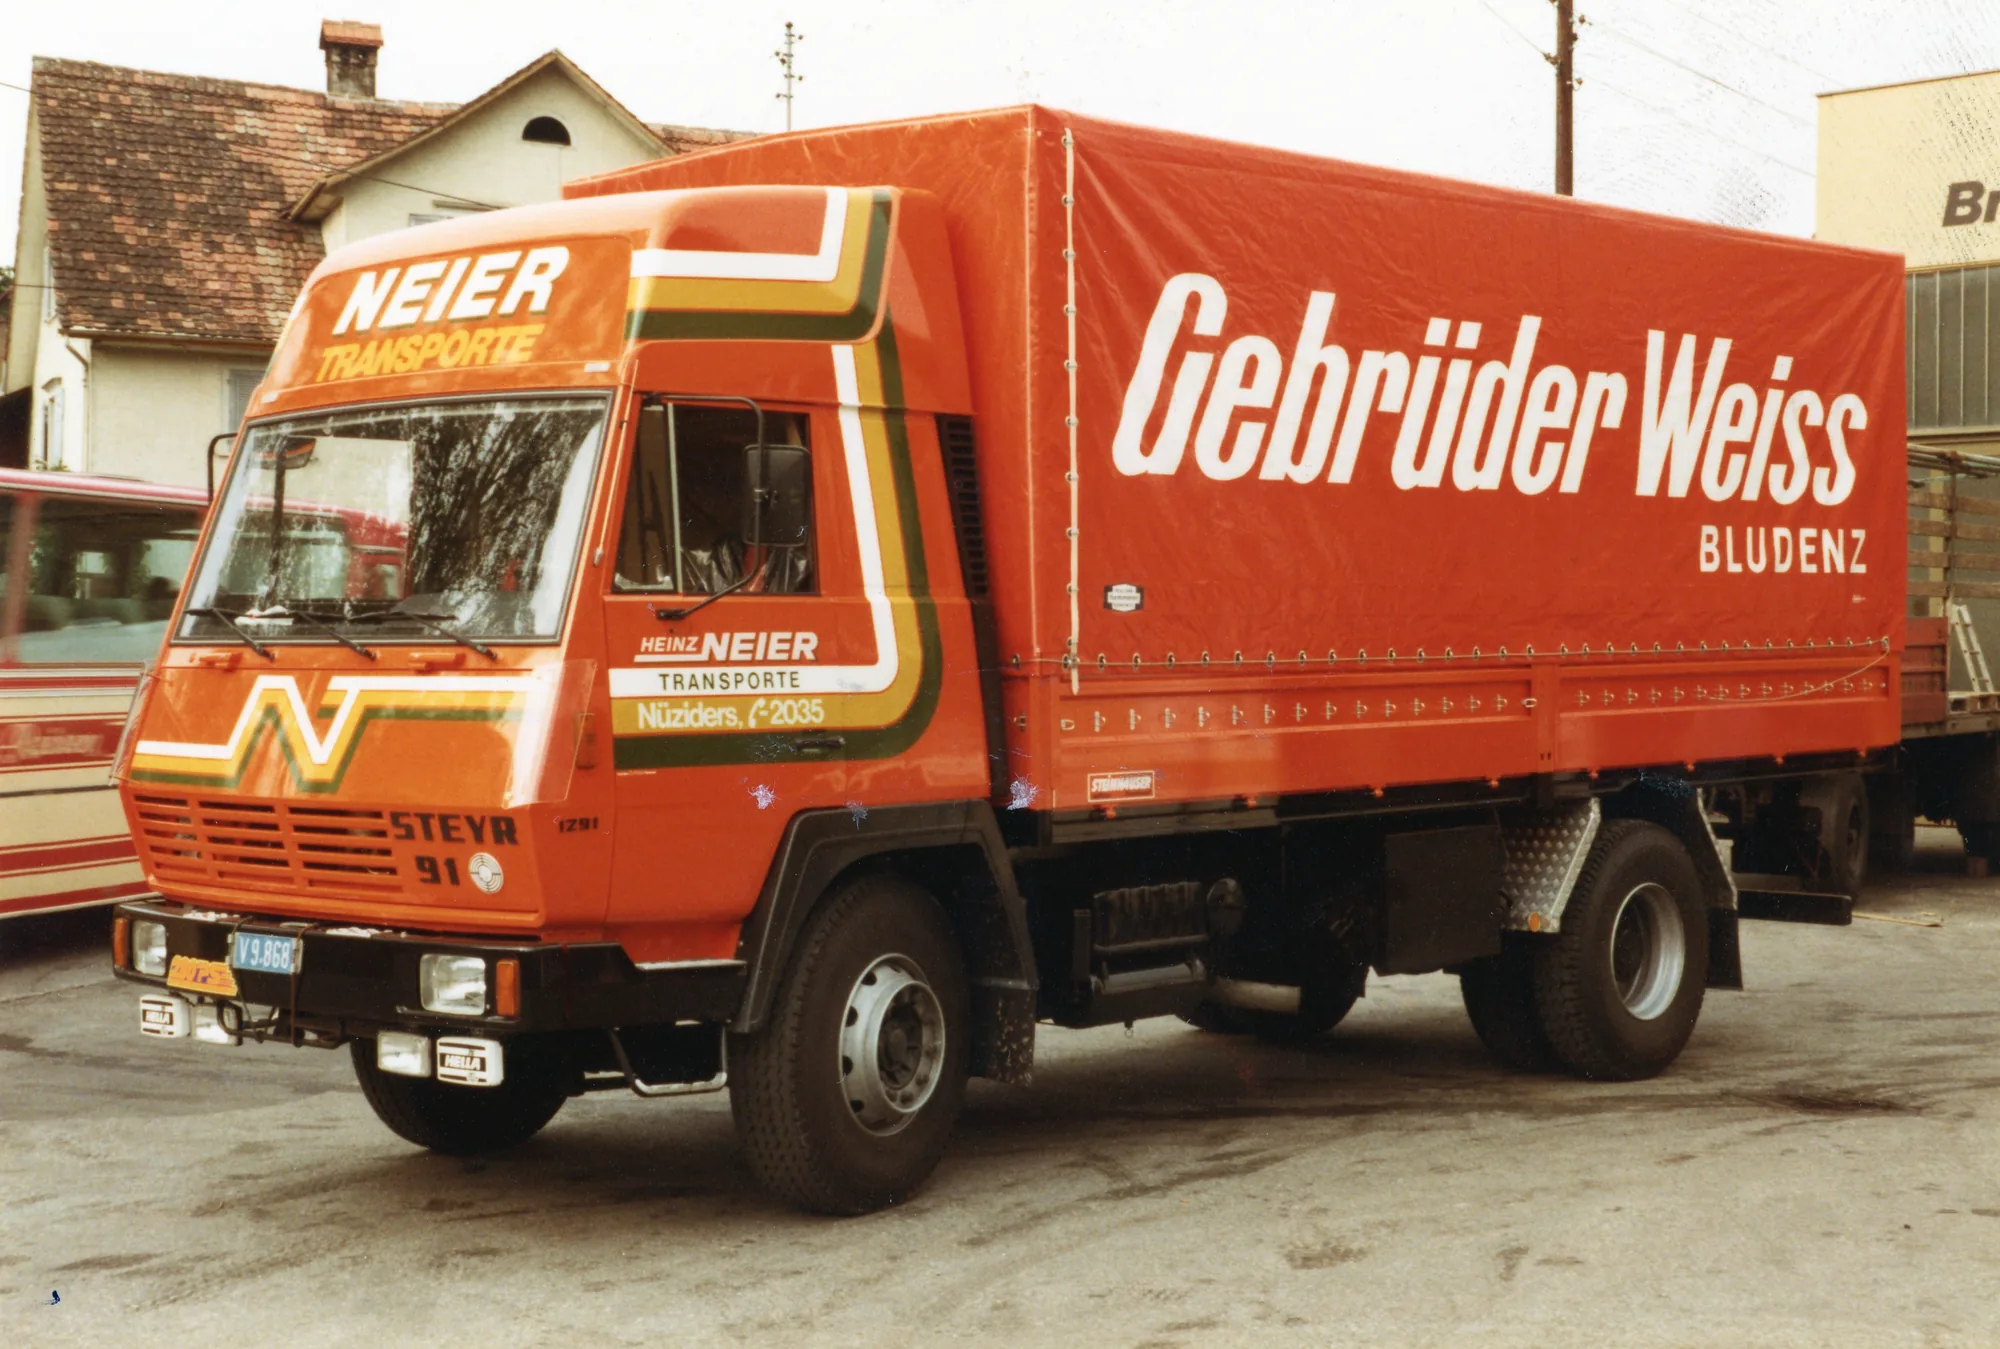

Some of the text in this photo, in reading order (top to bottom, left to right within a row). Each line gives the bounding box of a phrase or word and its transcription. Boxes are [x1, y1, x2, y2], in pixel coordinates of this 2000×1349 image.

[333, 246, 569, 335] NEIER
[317, 324, 545, 381] TRANSPORTE
[1112, 272, 1868, 505] Gebrüder Weiss
[1700, 525, 1867, 575] BLUDENZ
[640, 632, 818, 661] HEINZ NEIER
[659, 671, 800, 690] TRANSPORTE
[637, 700, 744, 729] Nüziders,
[389, 811, 519, 845] STEYR
[558, 817, 599, 833] 1291
[415, 855, 460, 885] 91
[240, 937, 290, 969] V 9.868
[444, 1054, 481, 1070] HELLA
